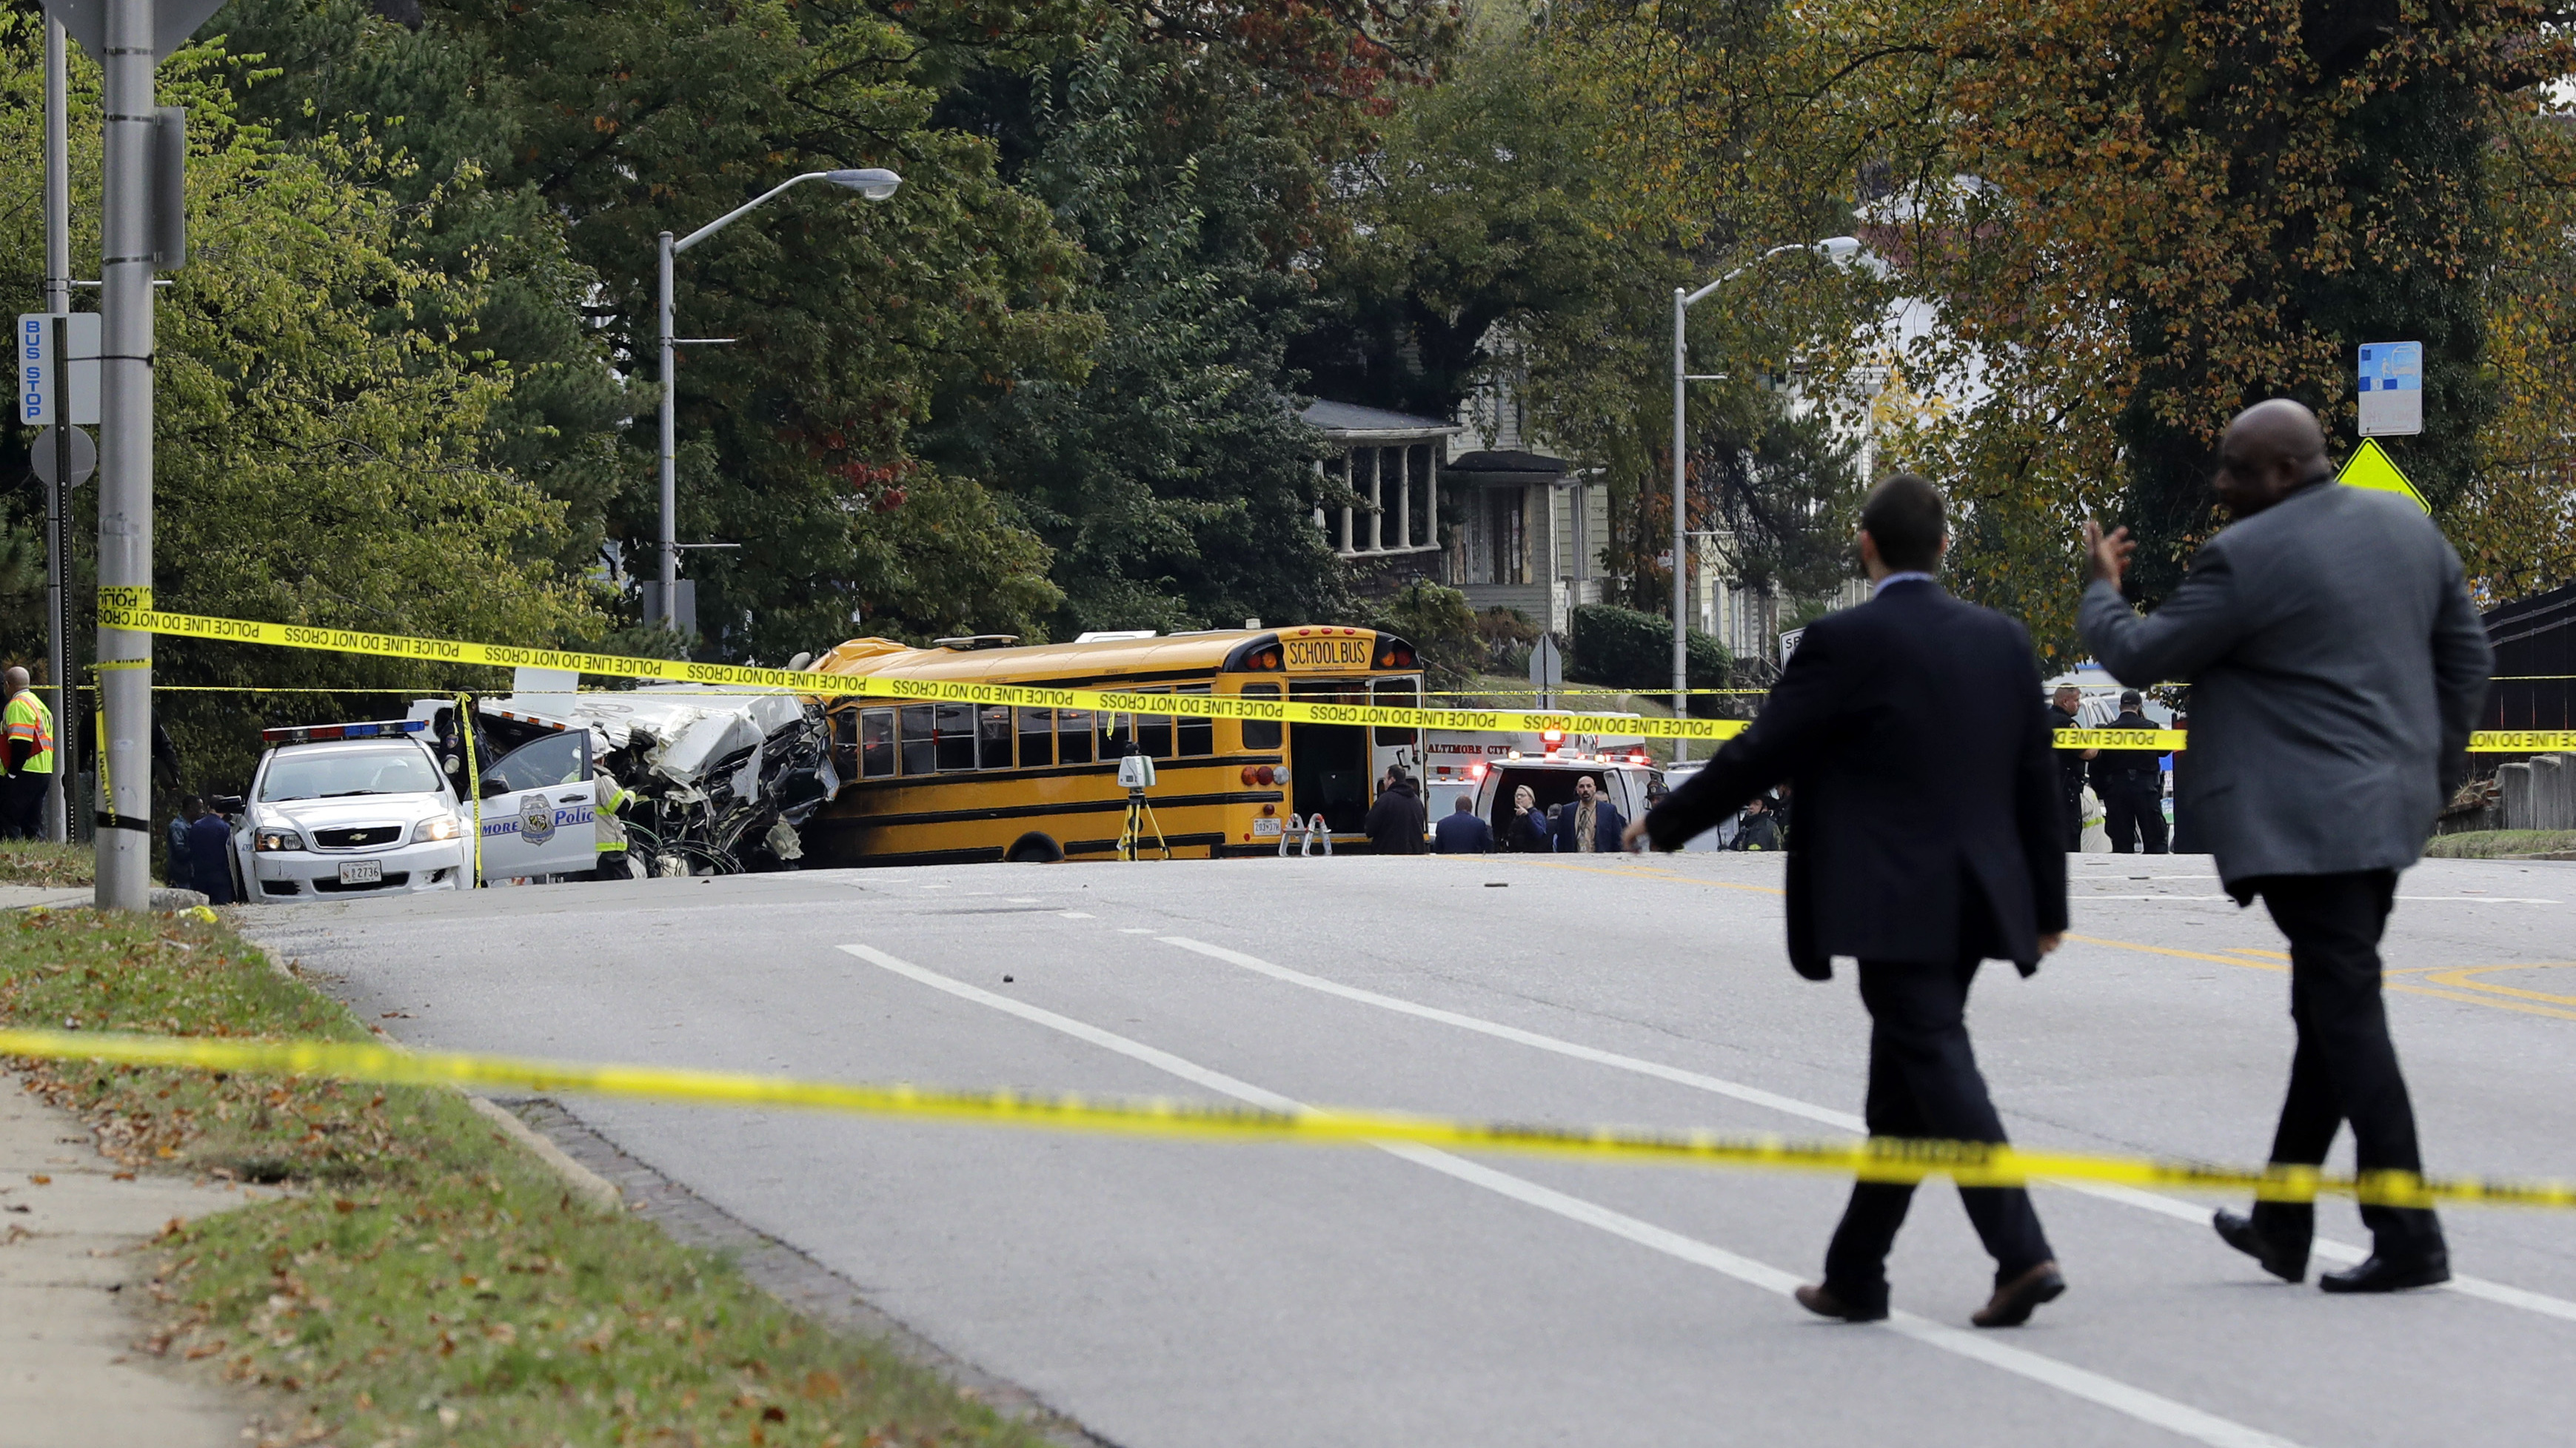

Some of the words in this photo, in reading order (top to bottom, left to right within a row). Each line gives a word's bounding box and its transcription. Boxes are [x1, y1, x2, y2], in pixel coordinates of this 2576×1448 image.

[25, 321, 40, 359] BUS
[26, 367, 41, 418] STOP
[98, 594, 137, 606] POLIC
[98, 609, 130, 625] CROS
[133, 613, 158, 628] NOT
[162, 615, 180, 630] DO
[184, 617, 210, 632] LINE
[215, 620, 259, 638] POLICE
[285, 628, 329, 645] CROSS
[332, 633, 358, 648] NOT
[361, 635, 379, 650] DO
[384, 637, 410, 652] LINE
[414, 640, 459, 657] POLICE
[485, 647, 529, 663] CROSS
[1289, 641, 1339, 664] SCHOOL
[1340, 641, 1365, 663] BUS
[534, 651, 559, 666] NOT
[562, 654, 581, 668] DO
[585, 656, 612, 671] LINE
[616, 659, 661, 674] POLICE
[688, 666, 732, 680] CROSS
[737, 669, 763, 683] NOT
[766, 671, 784, 683] DO
[788, 673, 817, 686] LINE
[820, 675, 867, 691] POLICE
[893, 680, 938, 696] CROSS
[943, 684, 968, 698] NOT
[971, 686, 991, 700] DO
[995, 688, 1023, 701] LINE
[1027, 689, 1074, 705] POLICE
[1100, 694, 1146, 710] CROSS
[1151, 697, 1177, 711] NOT
[1180, 698, 1200, 713] DO
[1203, 700, 1232, 714] LINE
[1234, 701, 1283, 717] POLICE
[1311, 706, 1357, 721] CROSS
[1361, 708, 1388, 723] NOT
[1392, 710, 1411, 723] DO
[1416, 711, 1444, 725] LINE
[1448, 714, 1496, 727] POLICE
[1524, 717, 1571, 730] CROSS
[1576, 718, 1602, 731] NOT
[1606, 720, 1626, 731] DO
[1630, 720, 1659, 733] LINE
[1664, 721, 1713, 735] POLICE
[2070, 731, 2100, 744] LINE
[2104, 731, 2156, 745] POLICE
[2475, 733, 2498, 747] NO
[1427, 744, 1482, 754] ALTIMORE
[1487, 745, 1512, 754] CITY
[481, 821, 518, 835] MORE
[555, 807, 595, 825] Polic
[358, 867, 379, 878] 2736
